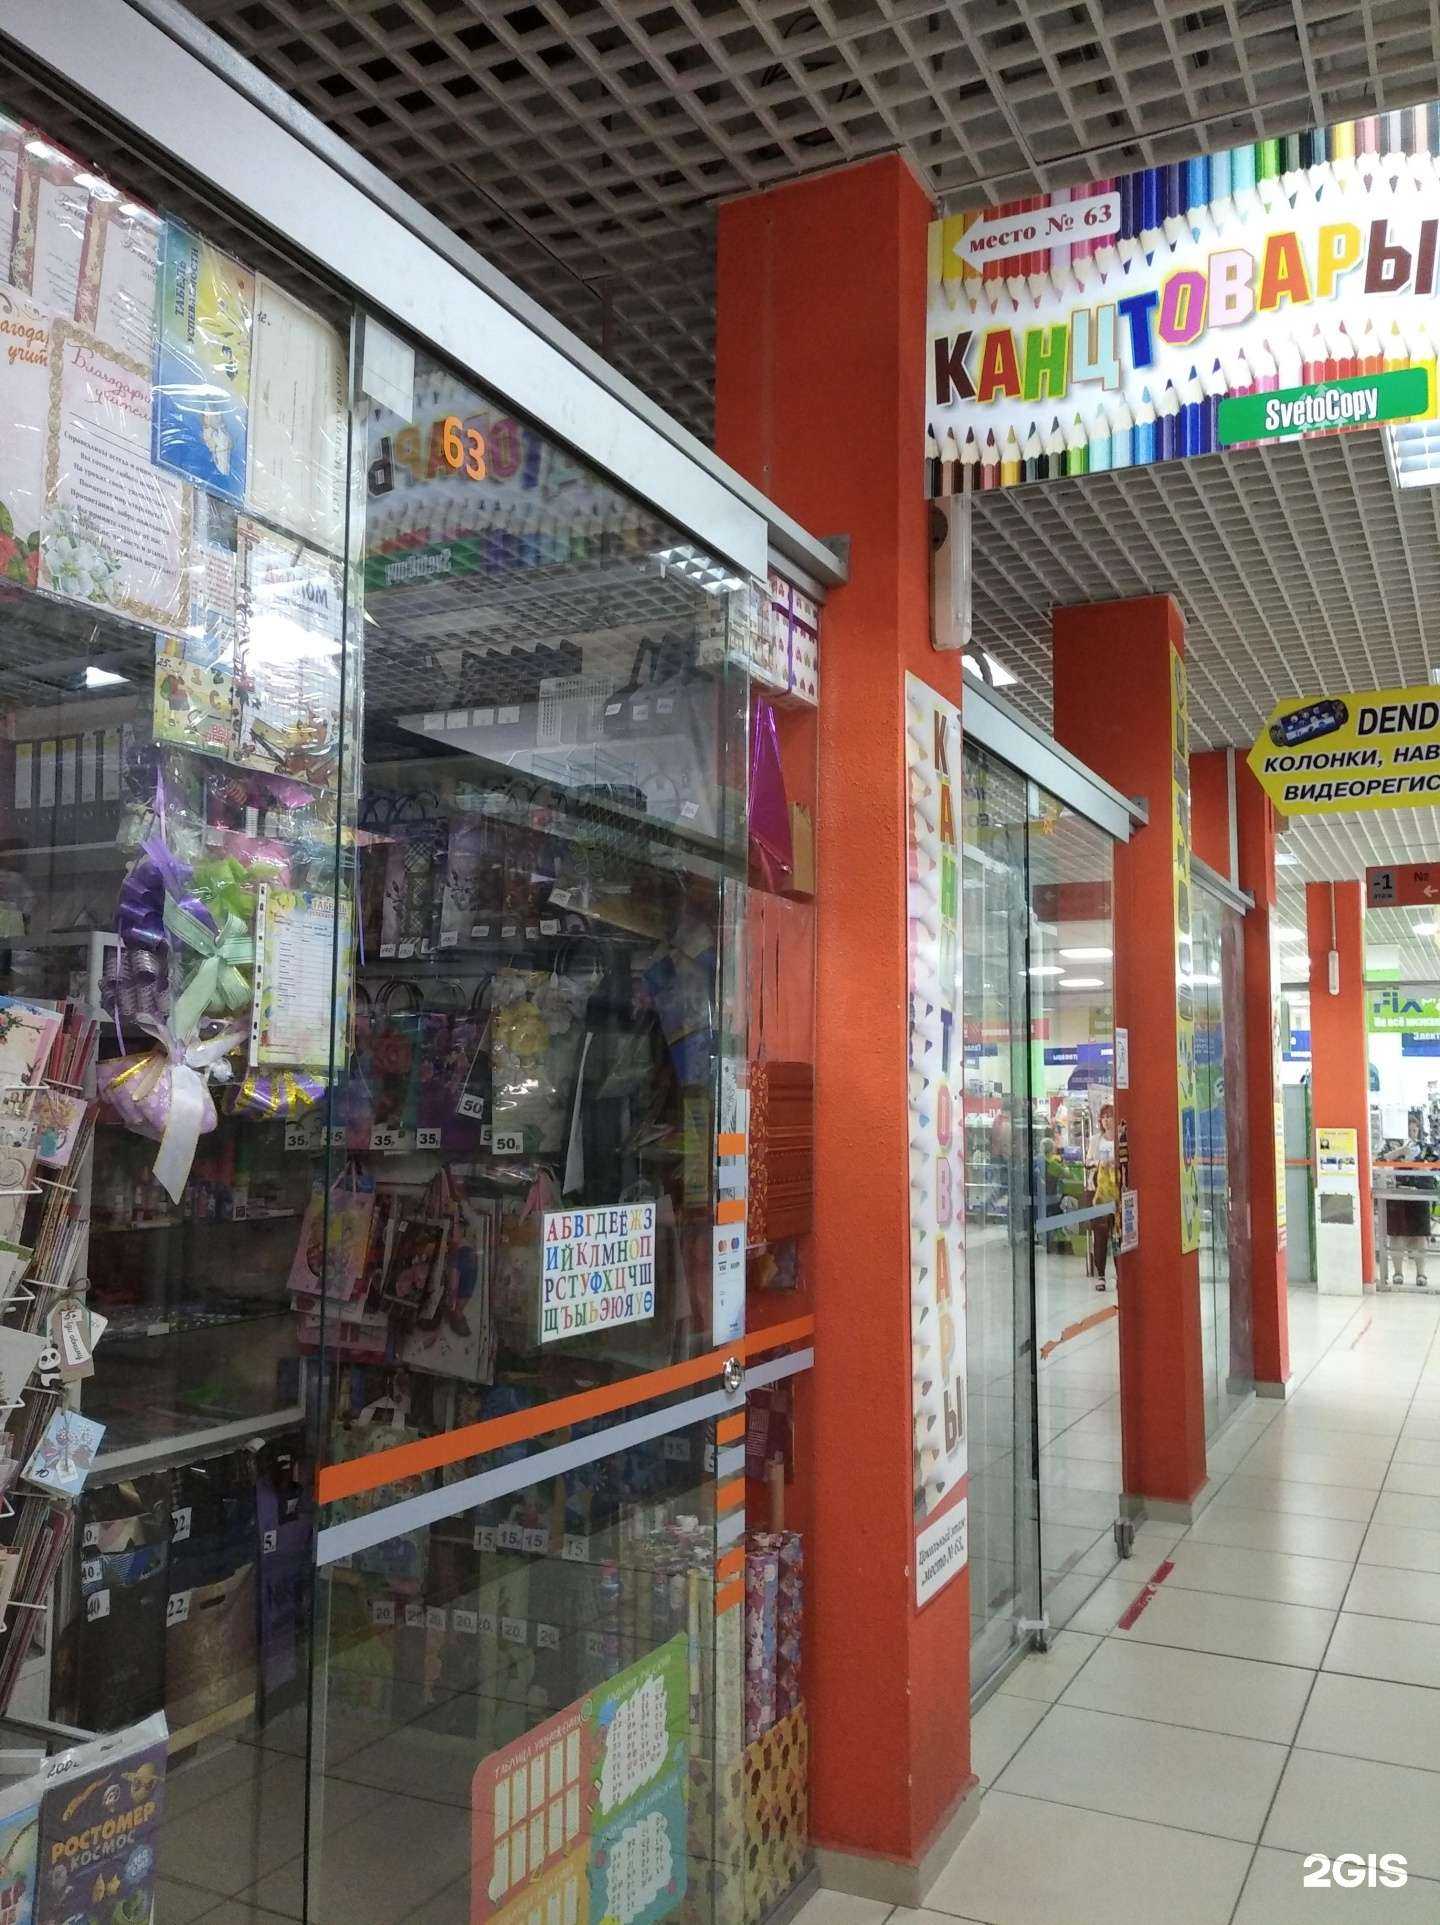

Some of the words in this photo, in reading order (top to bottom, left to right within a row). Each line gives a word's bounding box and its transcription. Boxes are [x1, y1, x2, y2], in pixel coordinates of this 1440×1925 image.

[969, 222, 1037, 254] место
[1045, 210, 1075, 234] №
[1084, 203, 1113, 227] 63
[933, 218, 1440, 406] КАНЦТОВАРЫ
[1264, 386, 1379, 431] SvetoCopy
[443, 415, 487, 481] 63
[1357, 701, 1440, 737] DEND
[1264, 749, 1384, 774] КОЛОНКИ,
[1393, 745, 1440, 764] НАВ
[1284, 774, 1440, 803] ВИДЕОРЕГИС
[52, 1802, 156, 1864] РОСТОМЕР
